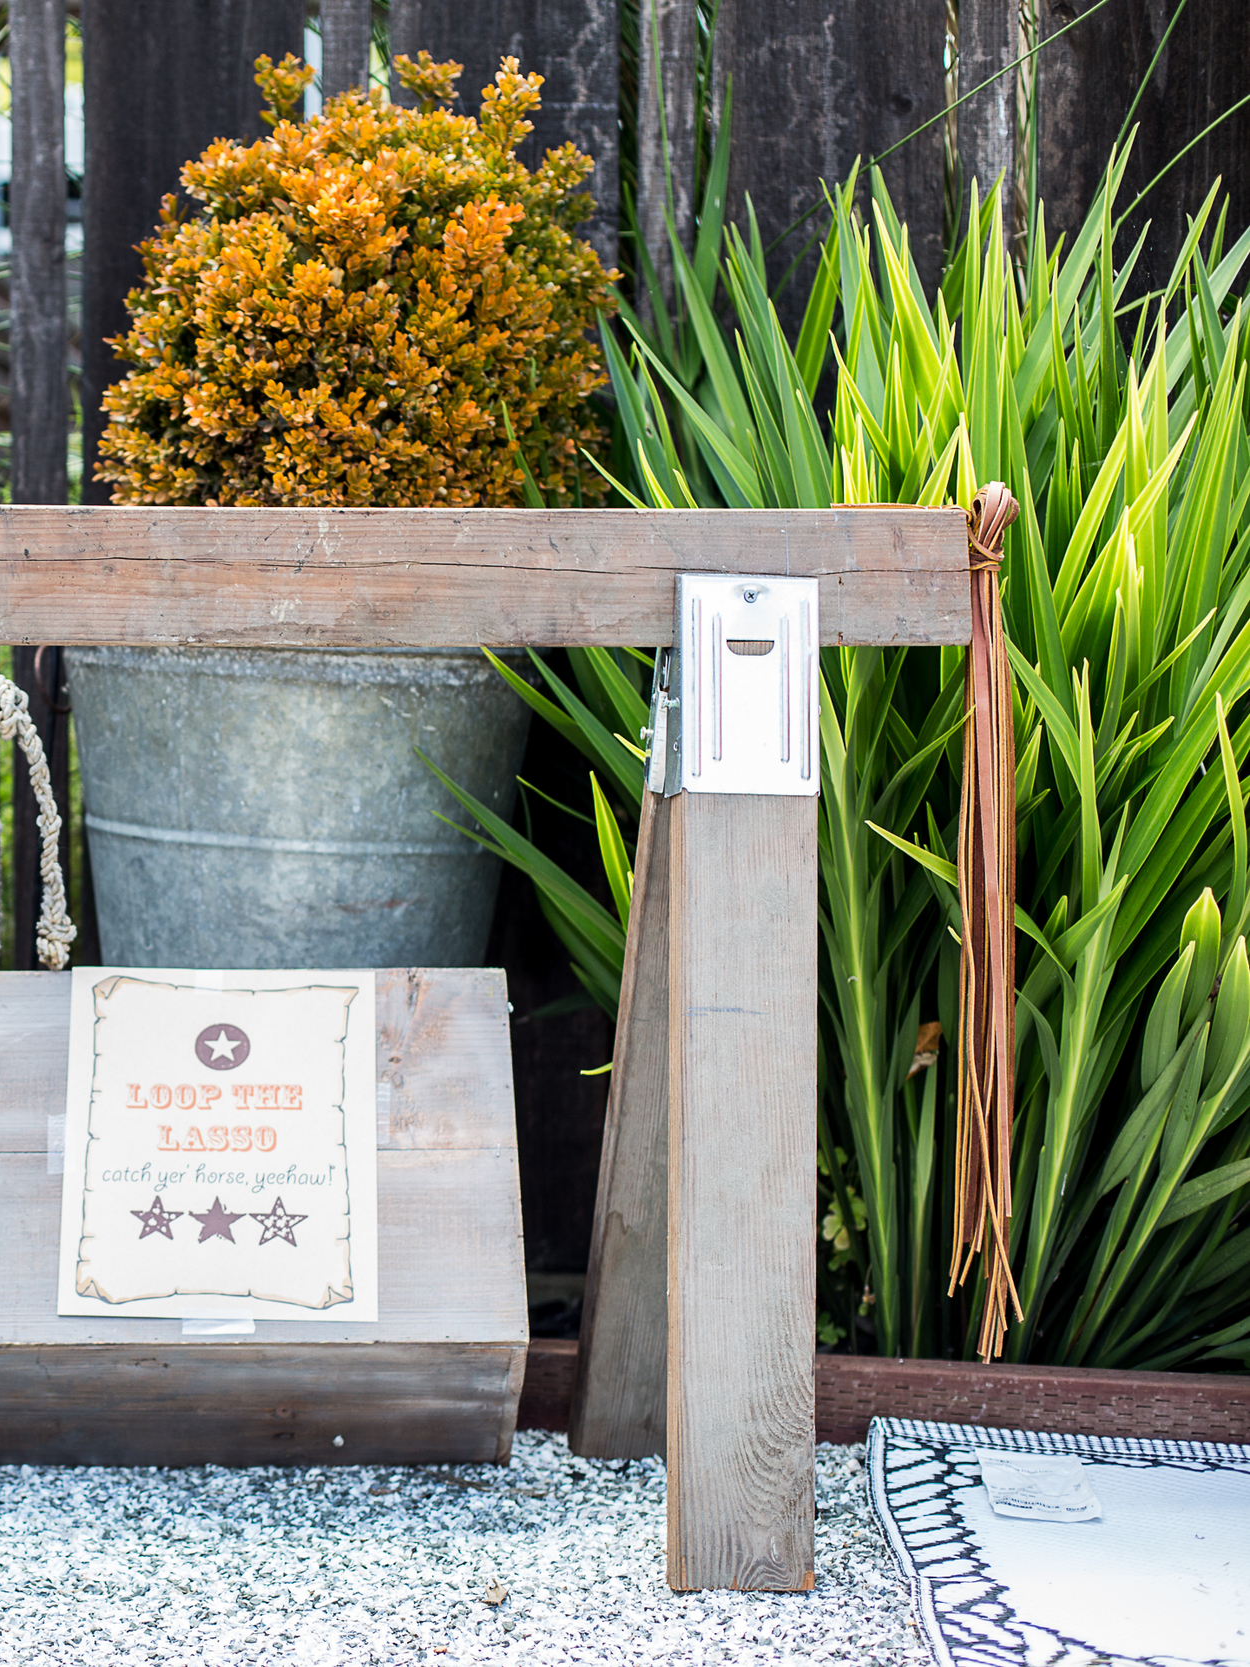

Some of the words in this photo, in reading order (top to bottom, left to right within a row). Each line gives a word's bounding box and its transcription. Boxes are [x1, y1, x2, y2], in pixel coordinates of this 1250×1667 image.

[125, 1082, 223, 1110] LOOP
[231, 1083, 303, 1111] THE
[156, 1124, 277, 1152] LASSO
[101, 1161, 152, 1183] catch
[194, 1162, 249, 1186] horse,
[251, 1163, 336, 1194] yeehaw!
